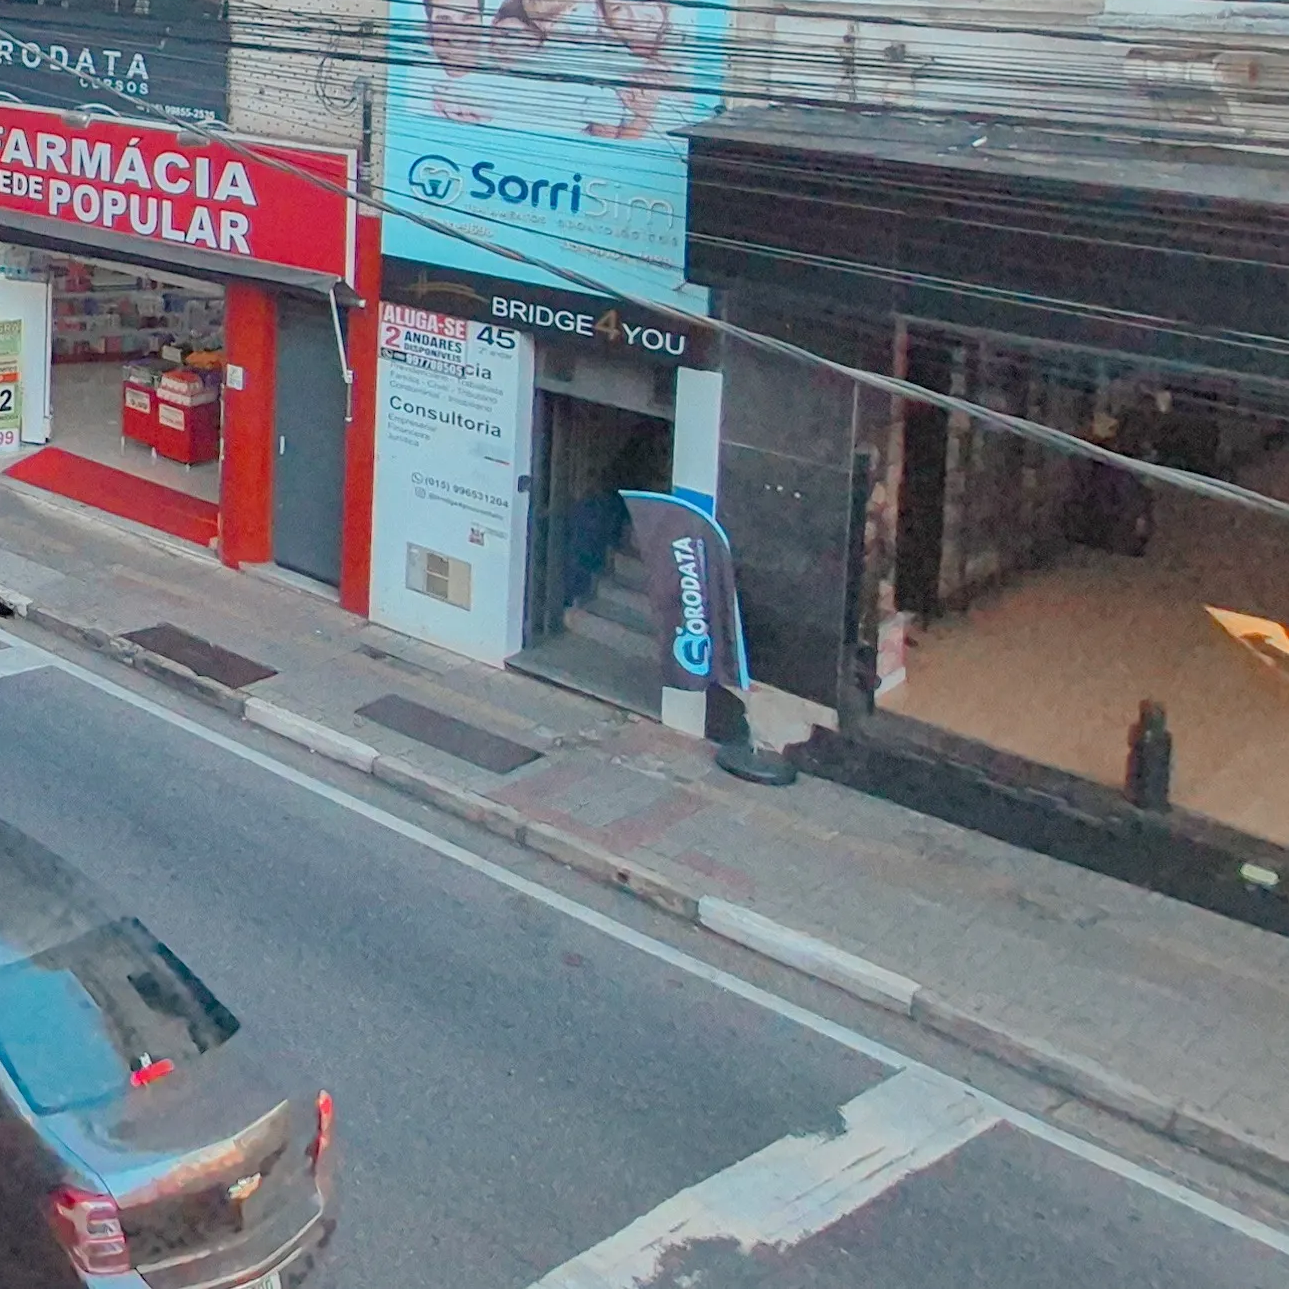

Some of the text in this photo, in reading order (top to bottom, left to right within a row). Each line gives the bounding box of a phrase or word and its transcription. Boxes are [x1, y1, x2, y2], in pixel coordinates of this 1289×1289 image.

[49, 178, 251, 254] POPULAR
[383, 304, 466, 339] ALUGA-SE
[477, 325, 516, 350] 45
[385, 325, 462, 354] 2 ANDARES
[390, 395, 502, 438] Consultoria
[425, 477, 450, 492] (015)
